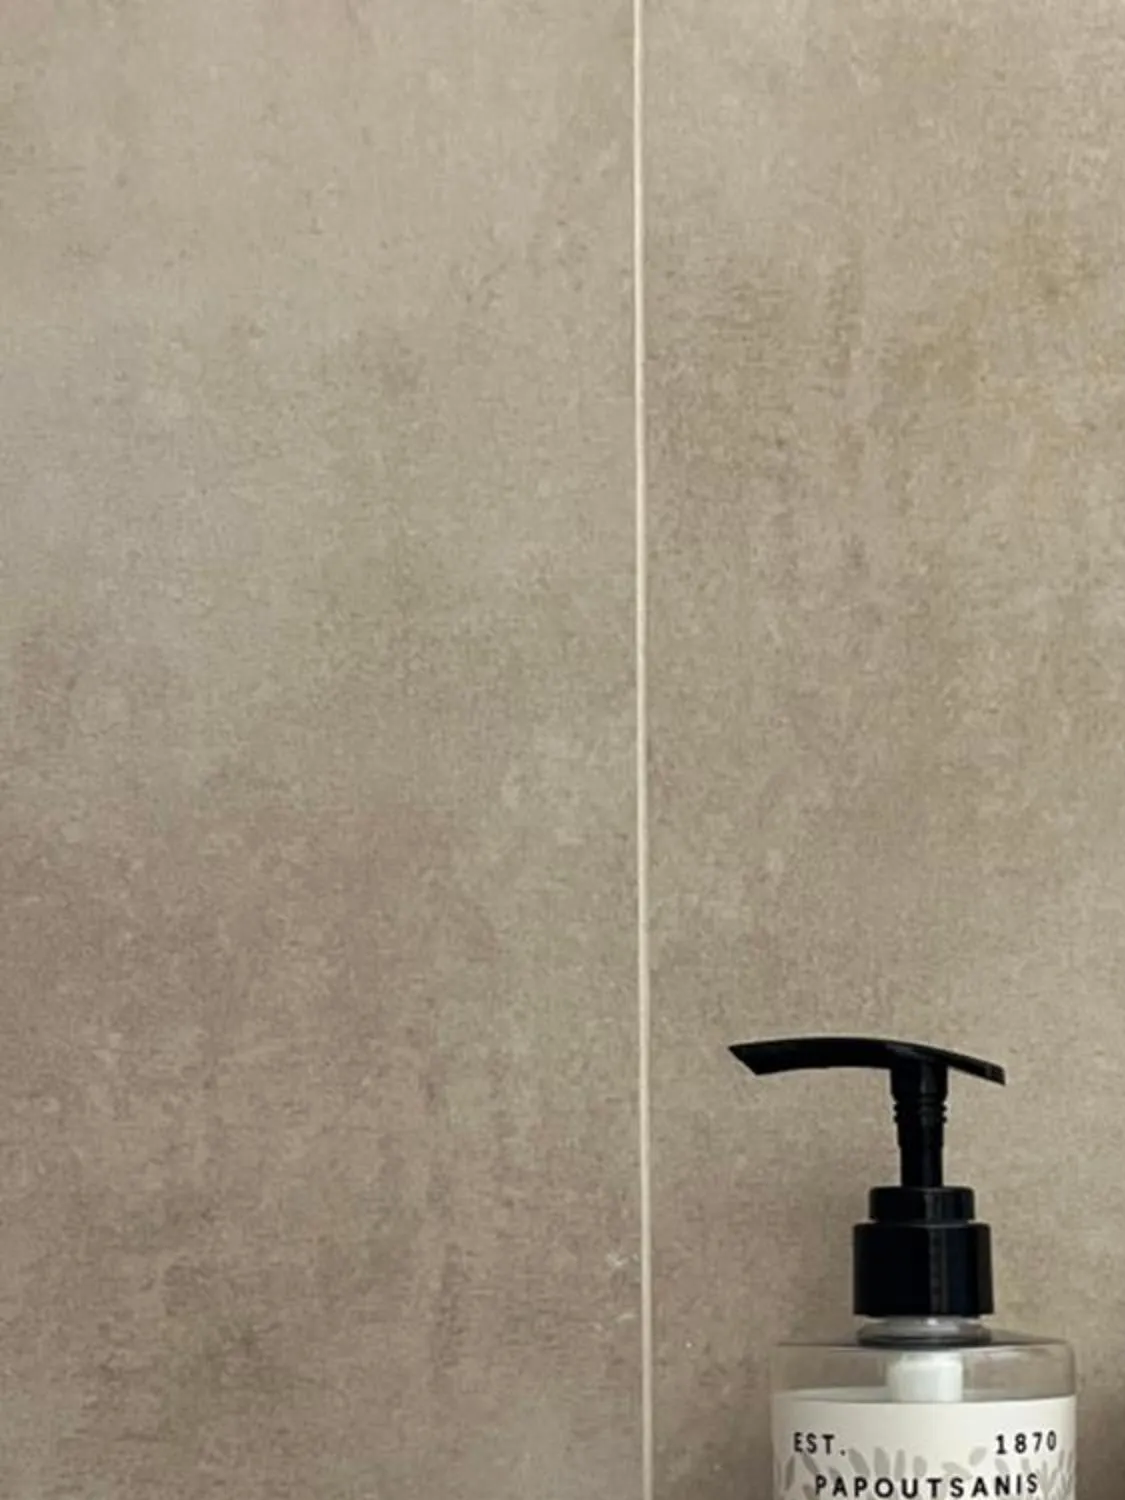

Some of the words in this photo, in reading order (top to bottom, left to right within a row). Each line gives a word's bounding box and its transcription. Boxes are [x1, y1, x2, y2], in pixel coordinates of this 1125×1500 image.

[794, 1432, 846, 1456] EST.
[995, 1430, 1057, 1455] 1870
[815, 1473, 1038, 1499] PAPOUTSANIS
